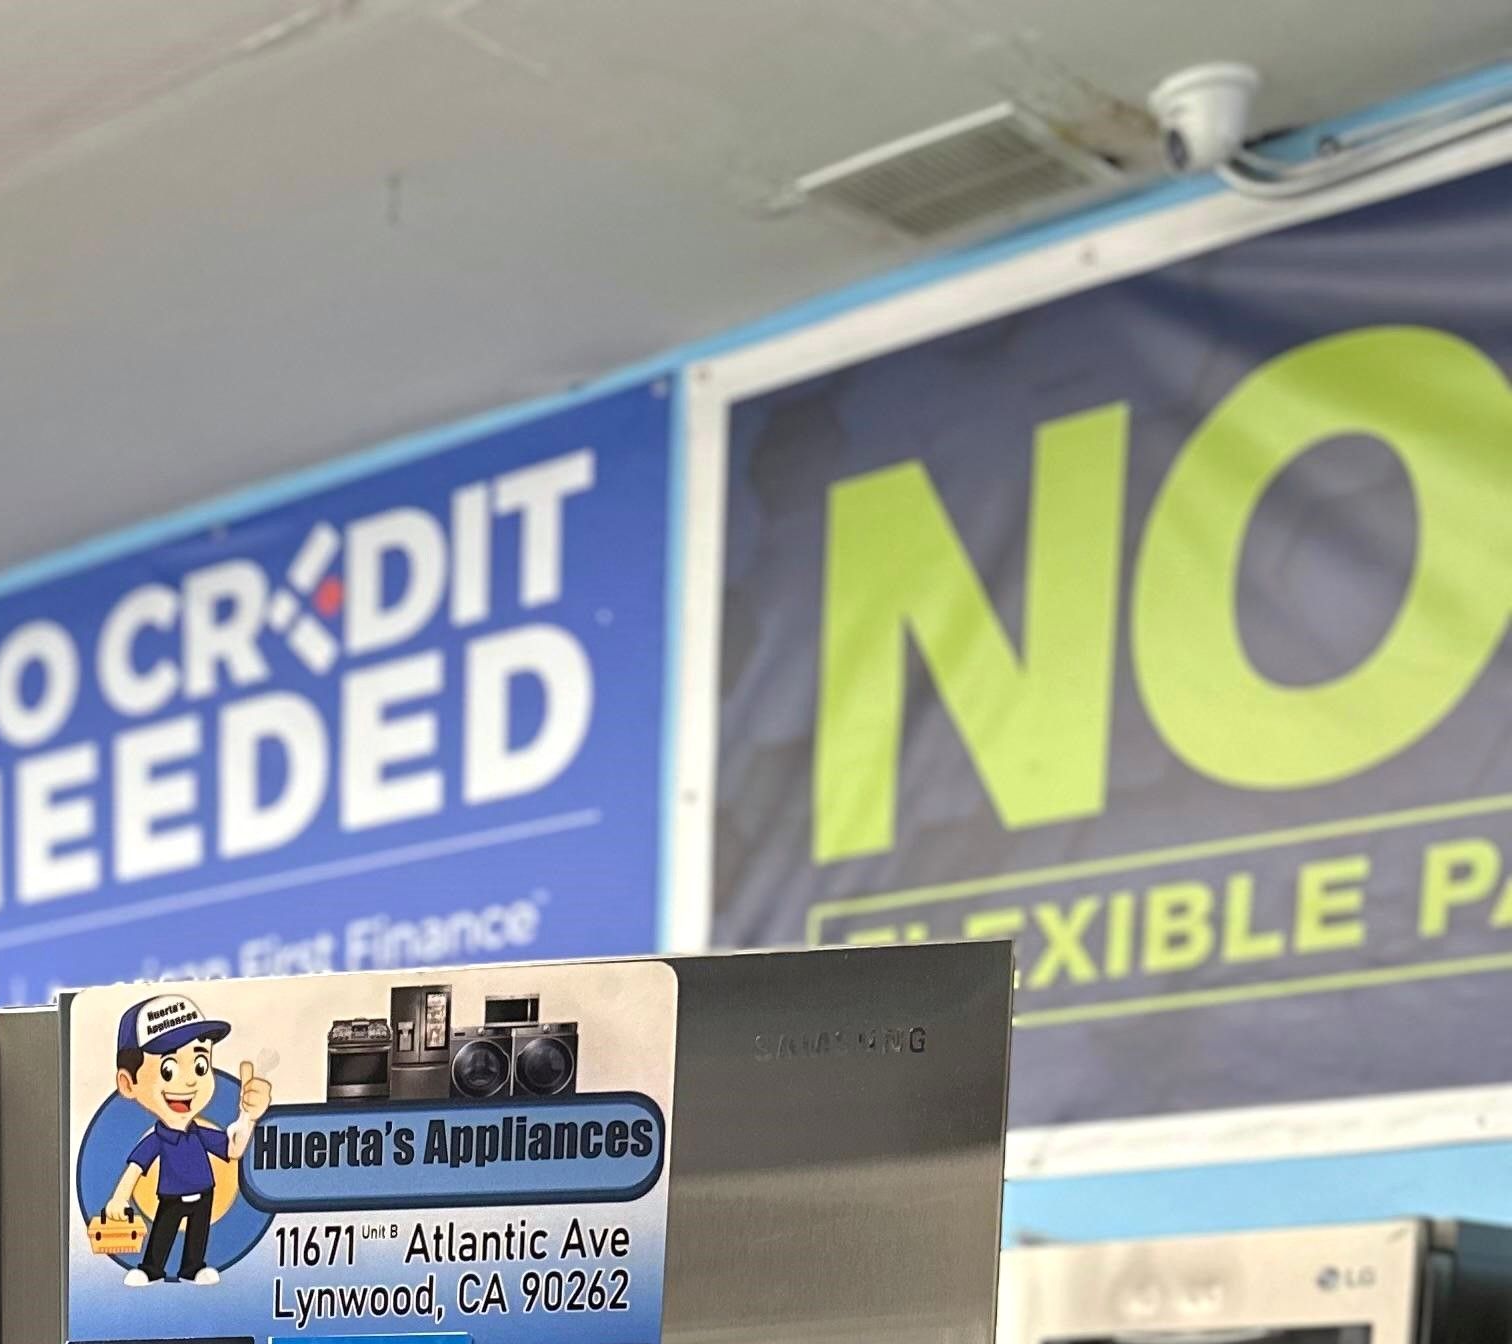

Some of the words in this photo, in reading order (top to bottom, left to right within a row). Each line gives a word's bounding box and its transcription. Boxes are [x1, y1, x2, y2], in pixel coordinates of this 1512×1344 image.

[812, 324, 1512, 865] NO
[1419, 838, 1512, 938] P
[344, 897, 541, 972] Finance
[146, 1011, 198, 1035] Appliances
[147, 1002, 186, 1021] Huerta's
[254, 1119, 414, 1171] Huerta's
[423, 1119, 654, 1169] Appliances
[275, 1225, 356, 1267] 11671
[361, 1224, 387, 1240] Unit
[390, 1223, 399, 1239] B
[405, 1220, 548, 1265] Atlantic
[559, 1218, 631, 1260] Ave
[274, 1275, 444, 1330] Lynwood,
[455, 1273, 507, 1313] CA
[521, 1269, 631, 1313] 90262
